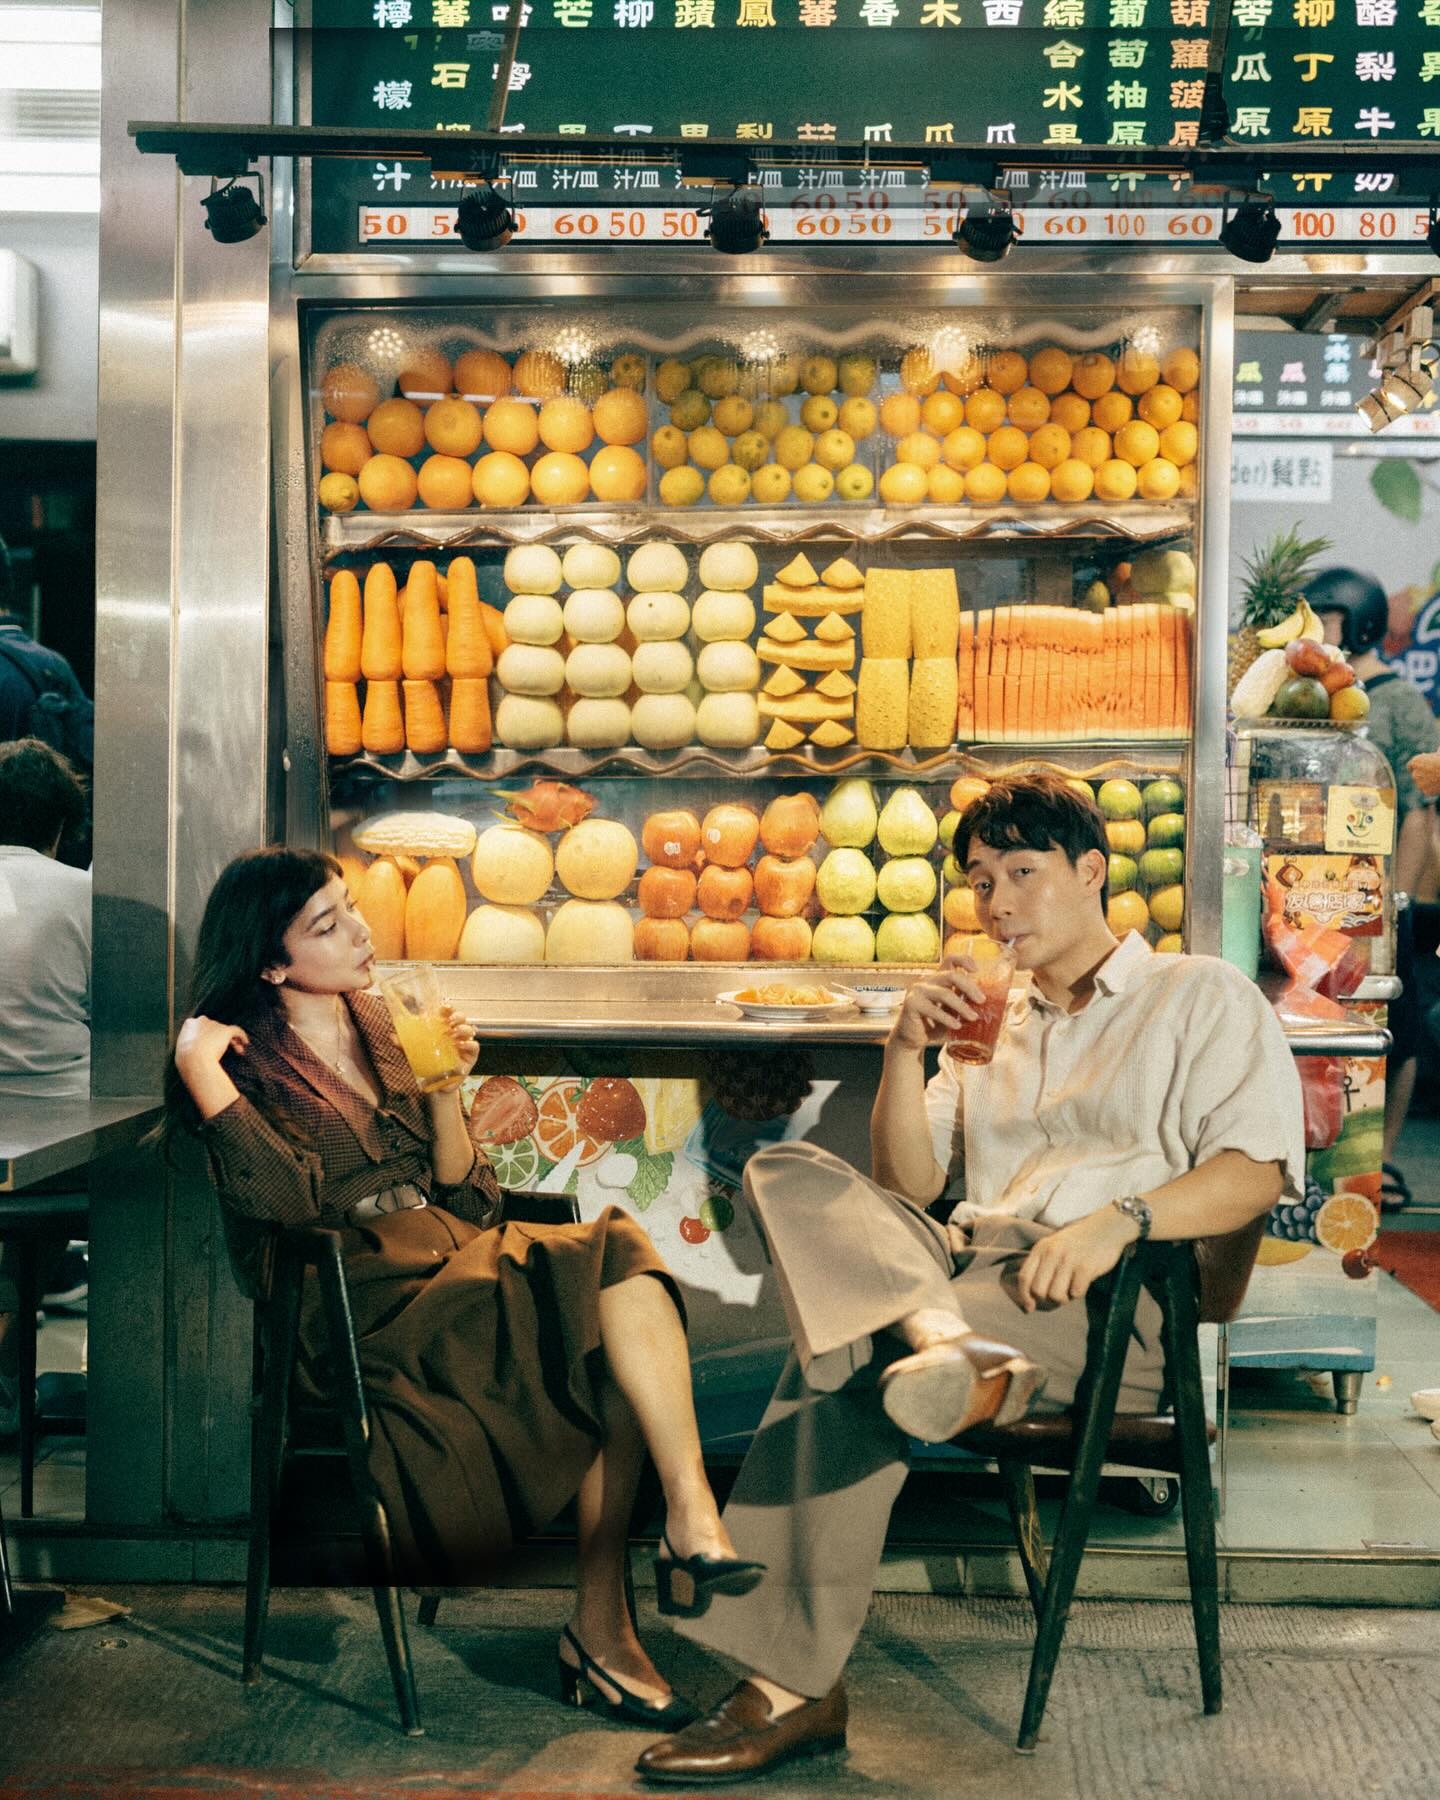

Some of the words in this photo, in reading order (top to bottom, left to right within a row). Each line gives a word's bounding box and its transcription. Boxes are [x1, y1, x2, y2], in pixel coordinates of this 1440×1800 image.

[363, 214, 407, 236] 50
[554, 213, 599, 235] 60
[609, 211, 645, 237] 50
[662, 211, 698, 237] 50
[796, 214, 841, 236] 60
[848, 213, 893, 235] 50
[1044, 215, 1088, 235] 60
[1103, 213, 1145, 236] 100
[1167, 214, 1213, 236] 60
[1292, 211, 1335, 237] 100
[1359, 212, 1396, 237] 80
